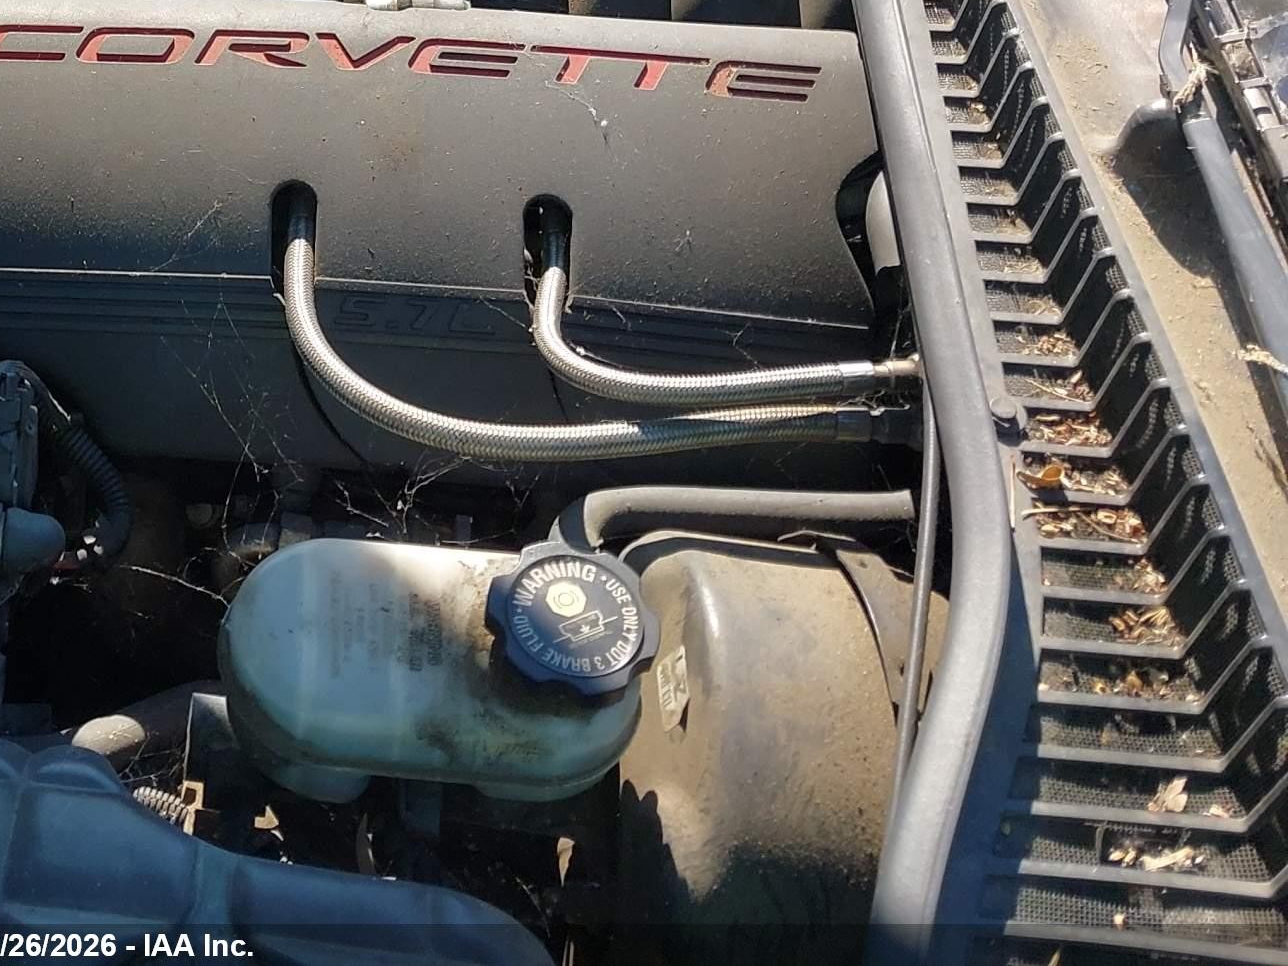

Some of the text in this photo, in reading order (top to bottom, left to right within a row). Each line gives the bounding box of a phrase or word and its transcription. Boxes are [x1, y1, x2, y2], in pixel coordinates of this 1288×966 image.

[512, 559, 597, 606] WARNING
[512, 579, 641, 673] USE ONLY DOT 3 BRAKE FLUID
